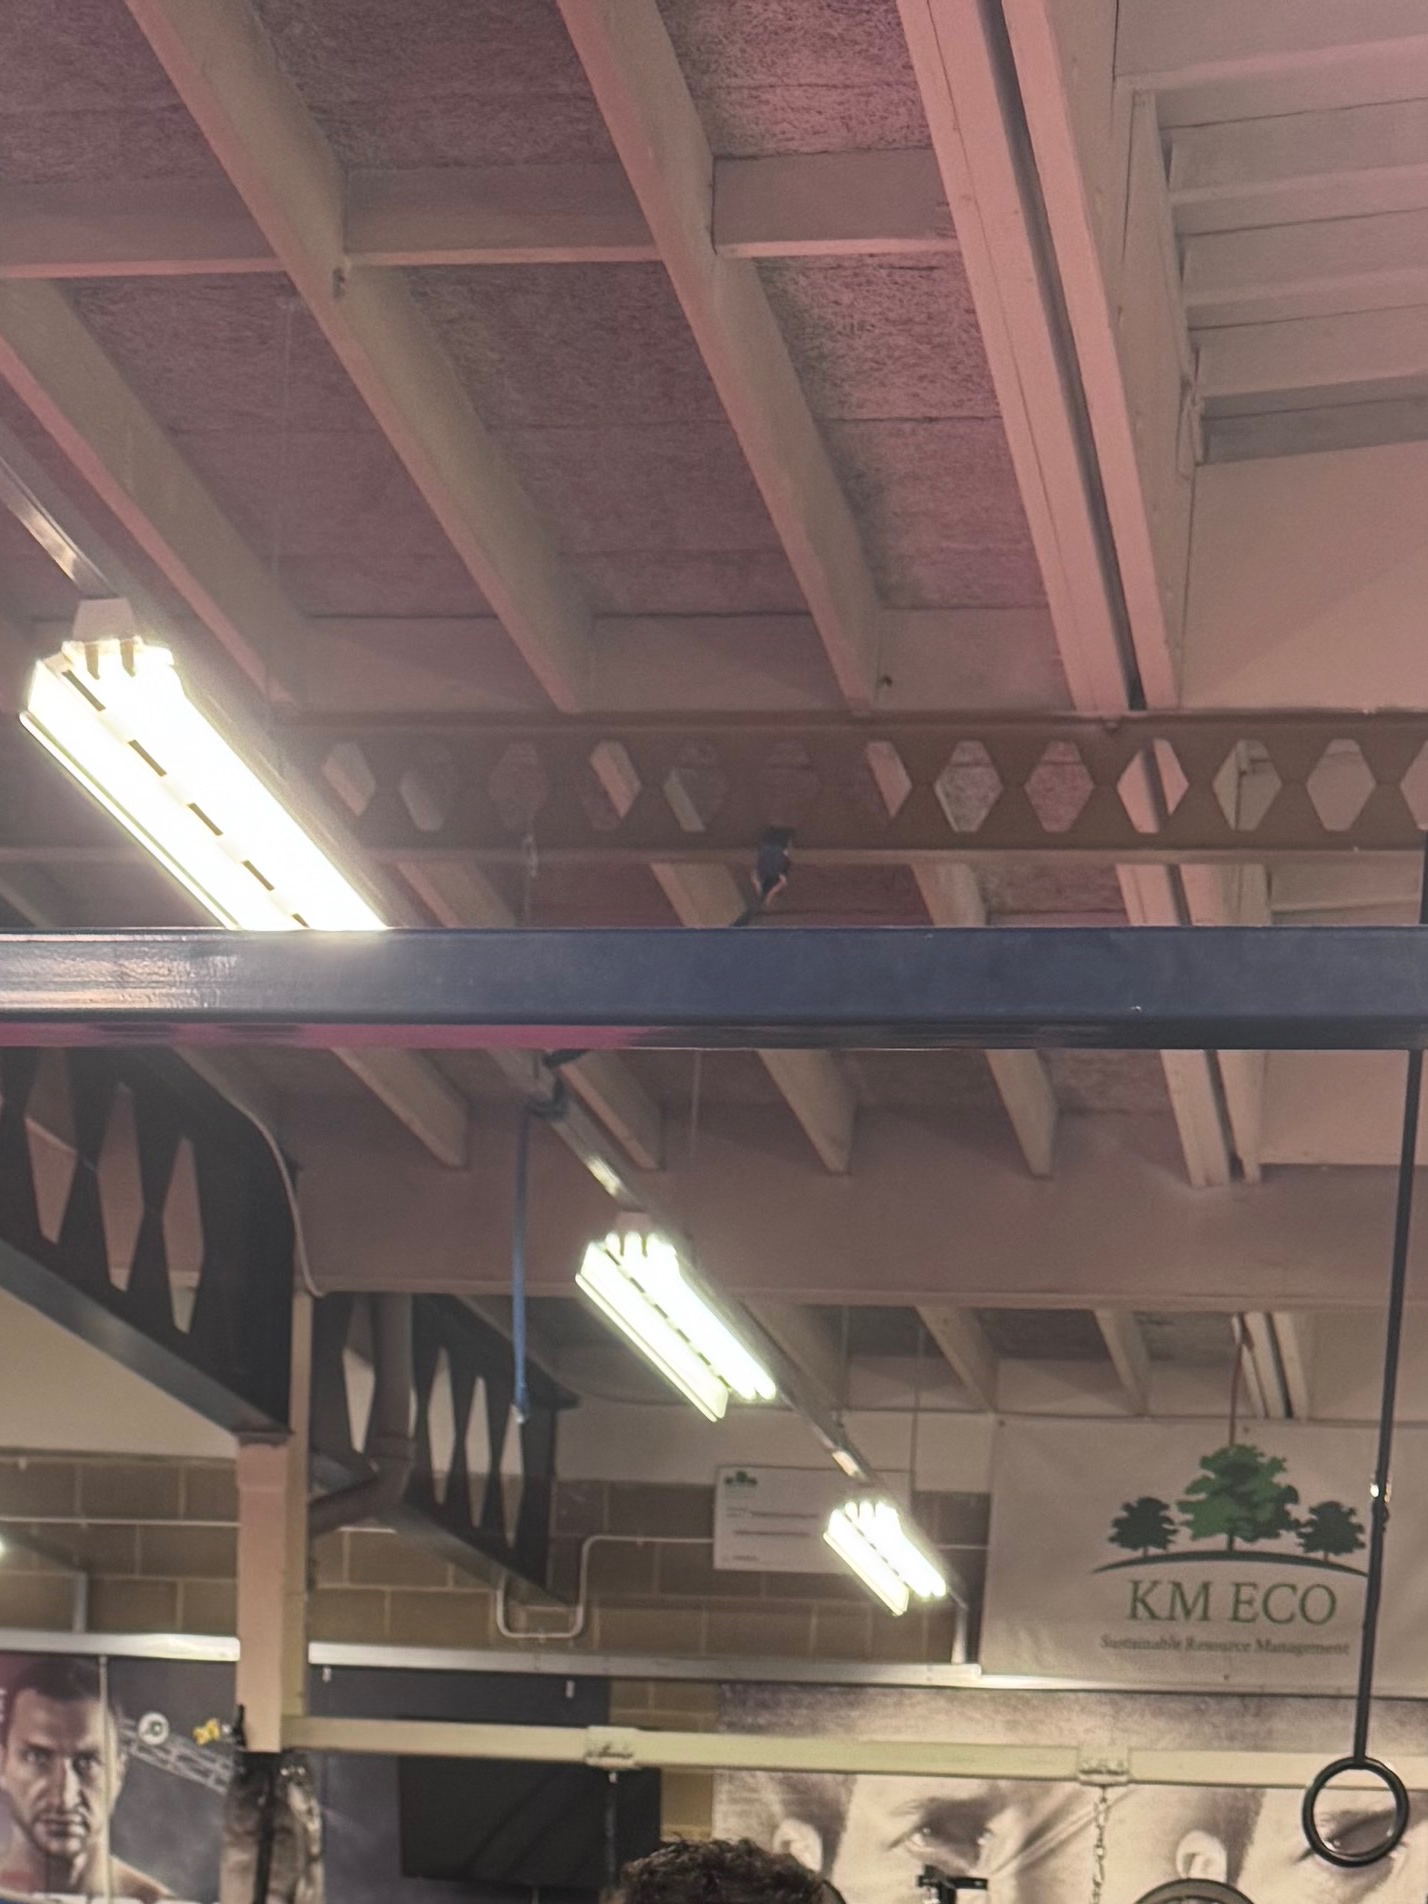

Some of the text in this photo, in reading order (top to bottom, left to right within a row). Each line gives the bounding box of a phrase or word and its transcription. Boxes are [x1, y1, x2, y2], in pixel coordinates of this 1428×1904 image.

[1126, 1579, 1338, 1626] KM ECO
[1256, 1637, 1351, 1656] Management
